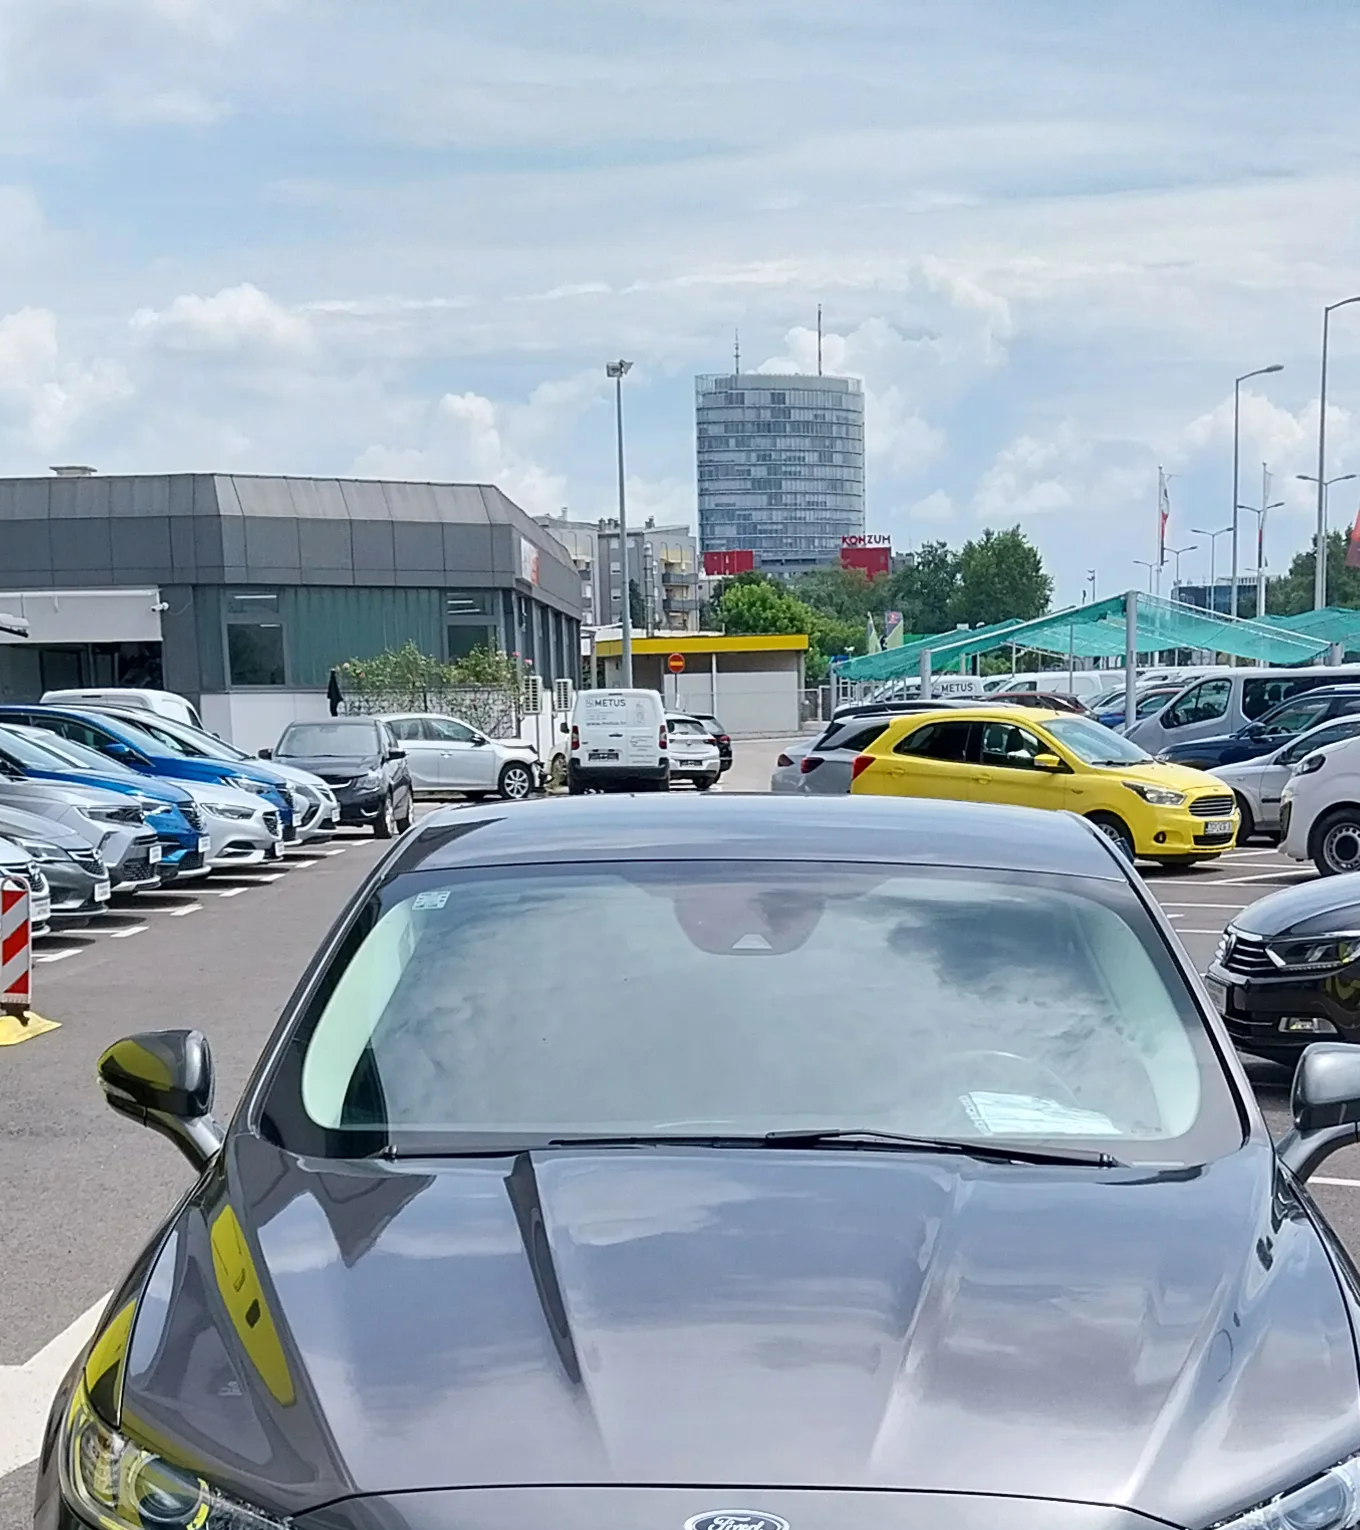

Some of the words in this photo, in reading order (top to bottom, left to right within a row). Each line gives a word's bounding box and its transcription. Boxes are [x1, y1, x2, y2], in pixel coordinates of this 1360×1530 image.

[841, 534, 891, 546] KONZUM
[941, 682, 974, 693] METUS
[594, 698, 627, 707] METUS
